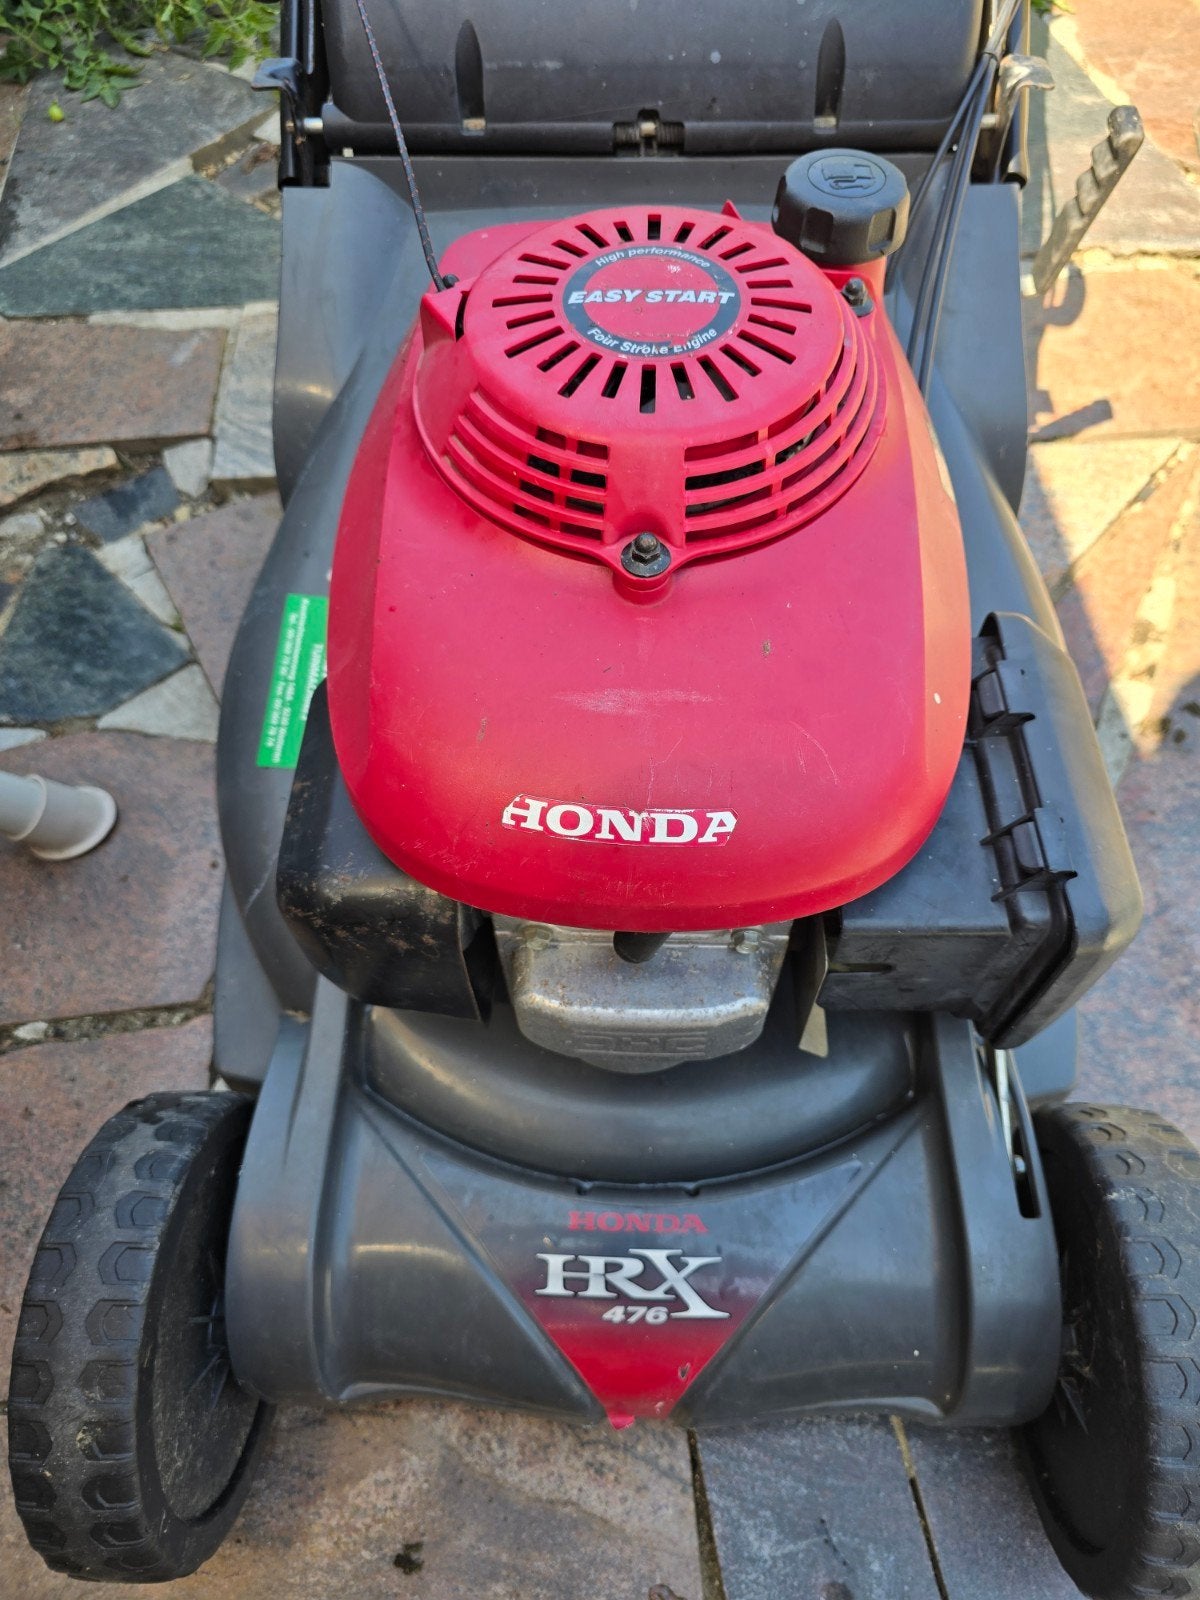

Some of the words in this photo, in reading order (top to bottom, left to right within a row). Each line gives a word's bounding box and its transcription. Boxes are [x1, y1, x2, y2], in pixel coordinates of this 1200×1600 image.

[595, 251, 625, 267] High
[628, 247, 710, 268] performance
[568, 289, 643, 305] EASY
[644, 289, 735, 305] START
[587, 327, 620, 347] Four
[620, 341, 669, 355] Stroke
[673, 328, 717, 353] Engine
[502, 796, 737, 843] HONDA
[568, 1210, 709, 1233] HONDA
[535, 1249, 731, 1318] HRX
[602, 1305, 669, 1324] 476
